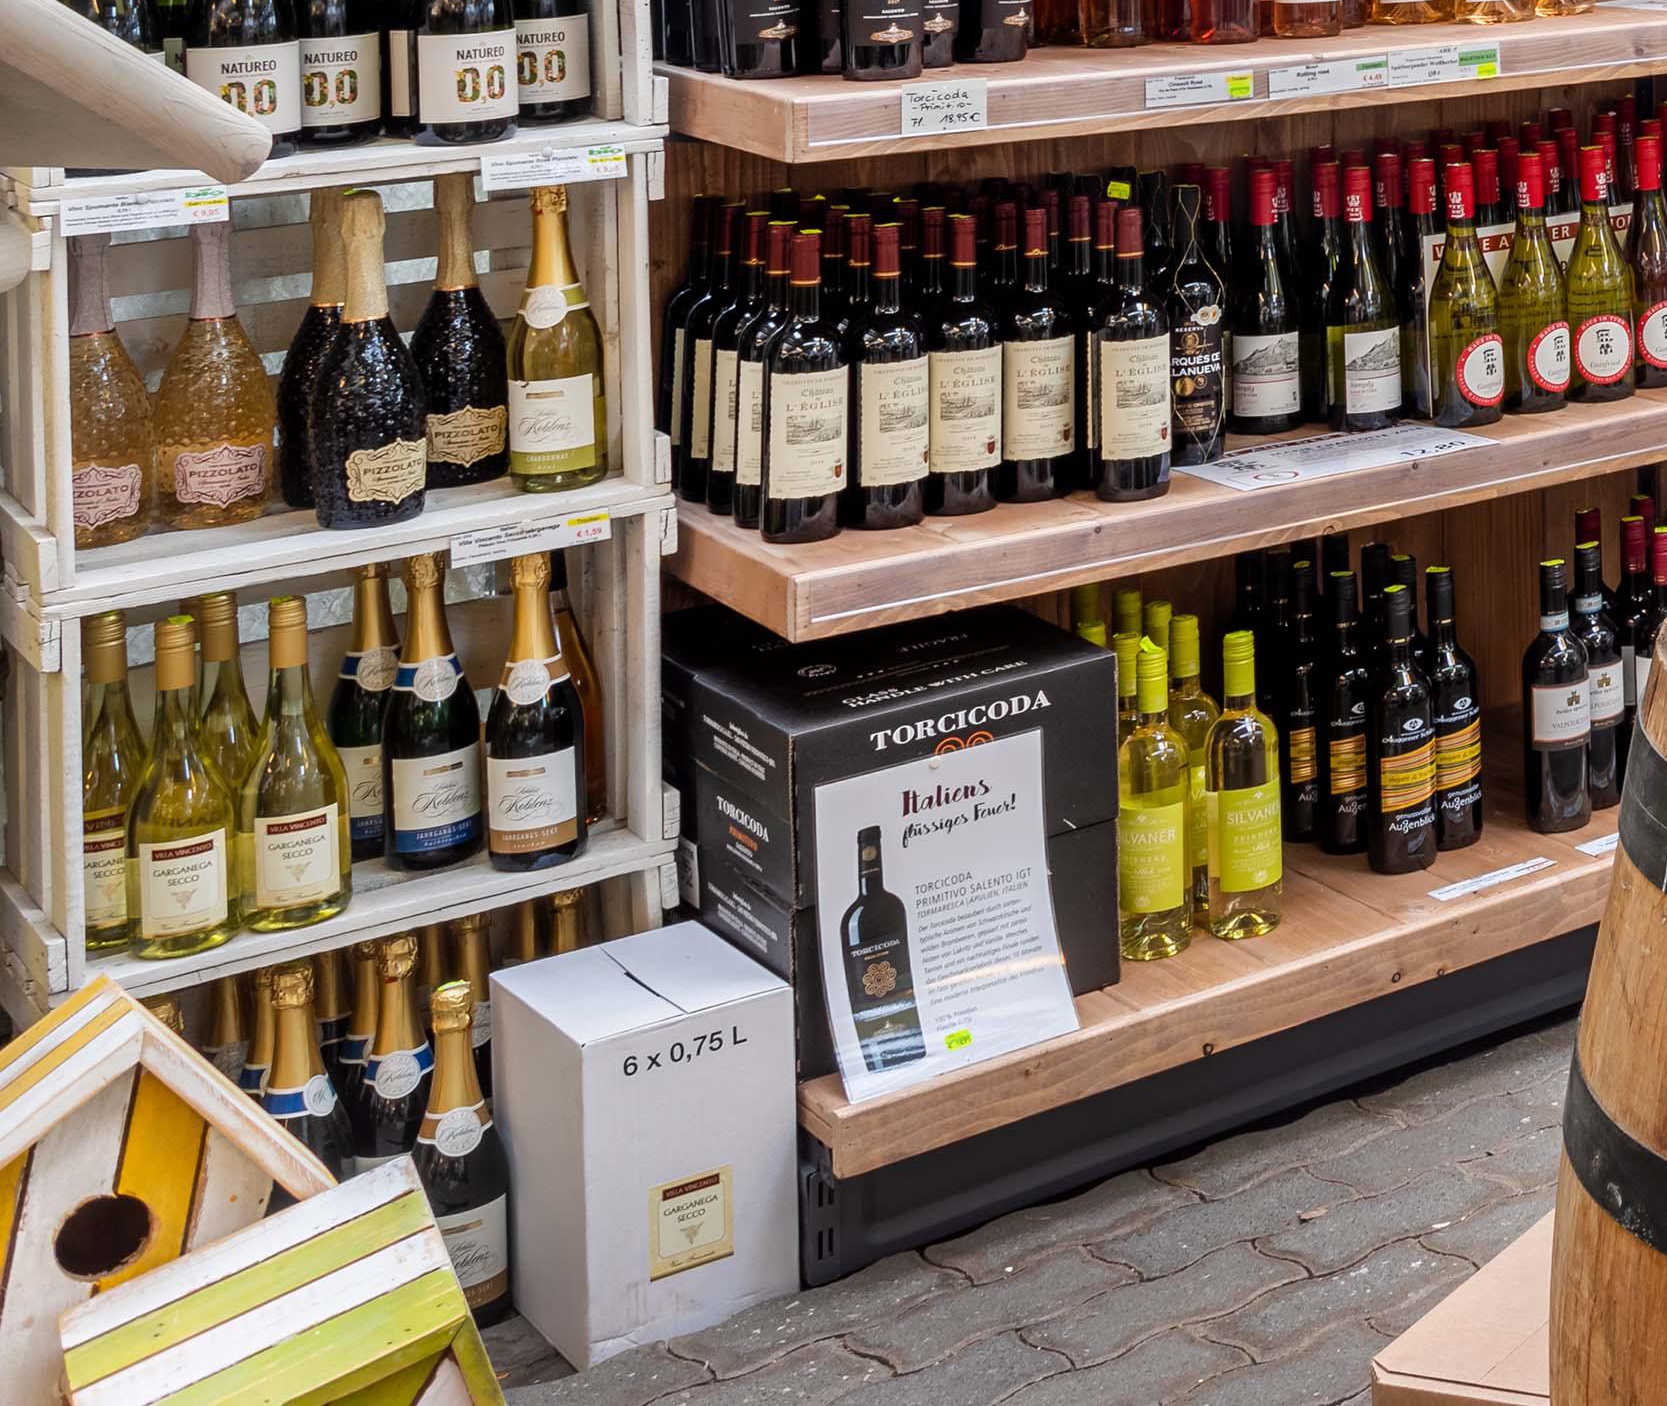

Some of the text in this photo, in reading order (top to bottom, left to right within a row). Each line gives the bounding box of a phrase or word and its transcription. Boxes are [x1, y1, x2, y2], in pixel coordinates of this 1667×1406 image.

[303, 48, 358, 65] NATUREO
[220, 59, 277, 76] NATUREO
[905, 91, 970, 105] Torcicoda
[434, 423, 499, 441] PIZZOLATO
[189, 460, 258, 482] PIZZOLATO
[849, 683, 917, 708] HANDLE
[979, 660, 1028, 678] CARE
[870, 689, 1052, 751] TORCICODA
[901, 775, 993, 817] Italiens
[716, 794, 770, 844] TORCICODA
[901, 792, 1017, 848] flüssiges Feuer!
[1388, 814, 1436, 834] Augenblick
[152, 847, 176, 860] VILLA
[152, 860, 213, 879] GARGANEGA
[166, 873, 200, 888] SECCO
[915, 871, 973, 895] TORCICODA
[916, 867, 1032, 909] PRIMITIVO SALENTO IGT
[851, 938, 900, 957] TORCICODA
[622, 1025, 748, 1077] 6 x 0,75 L
[663, 1193, 719, 1222] GARGANEGA
[677, 1209, 707, 1225] SECCO
